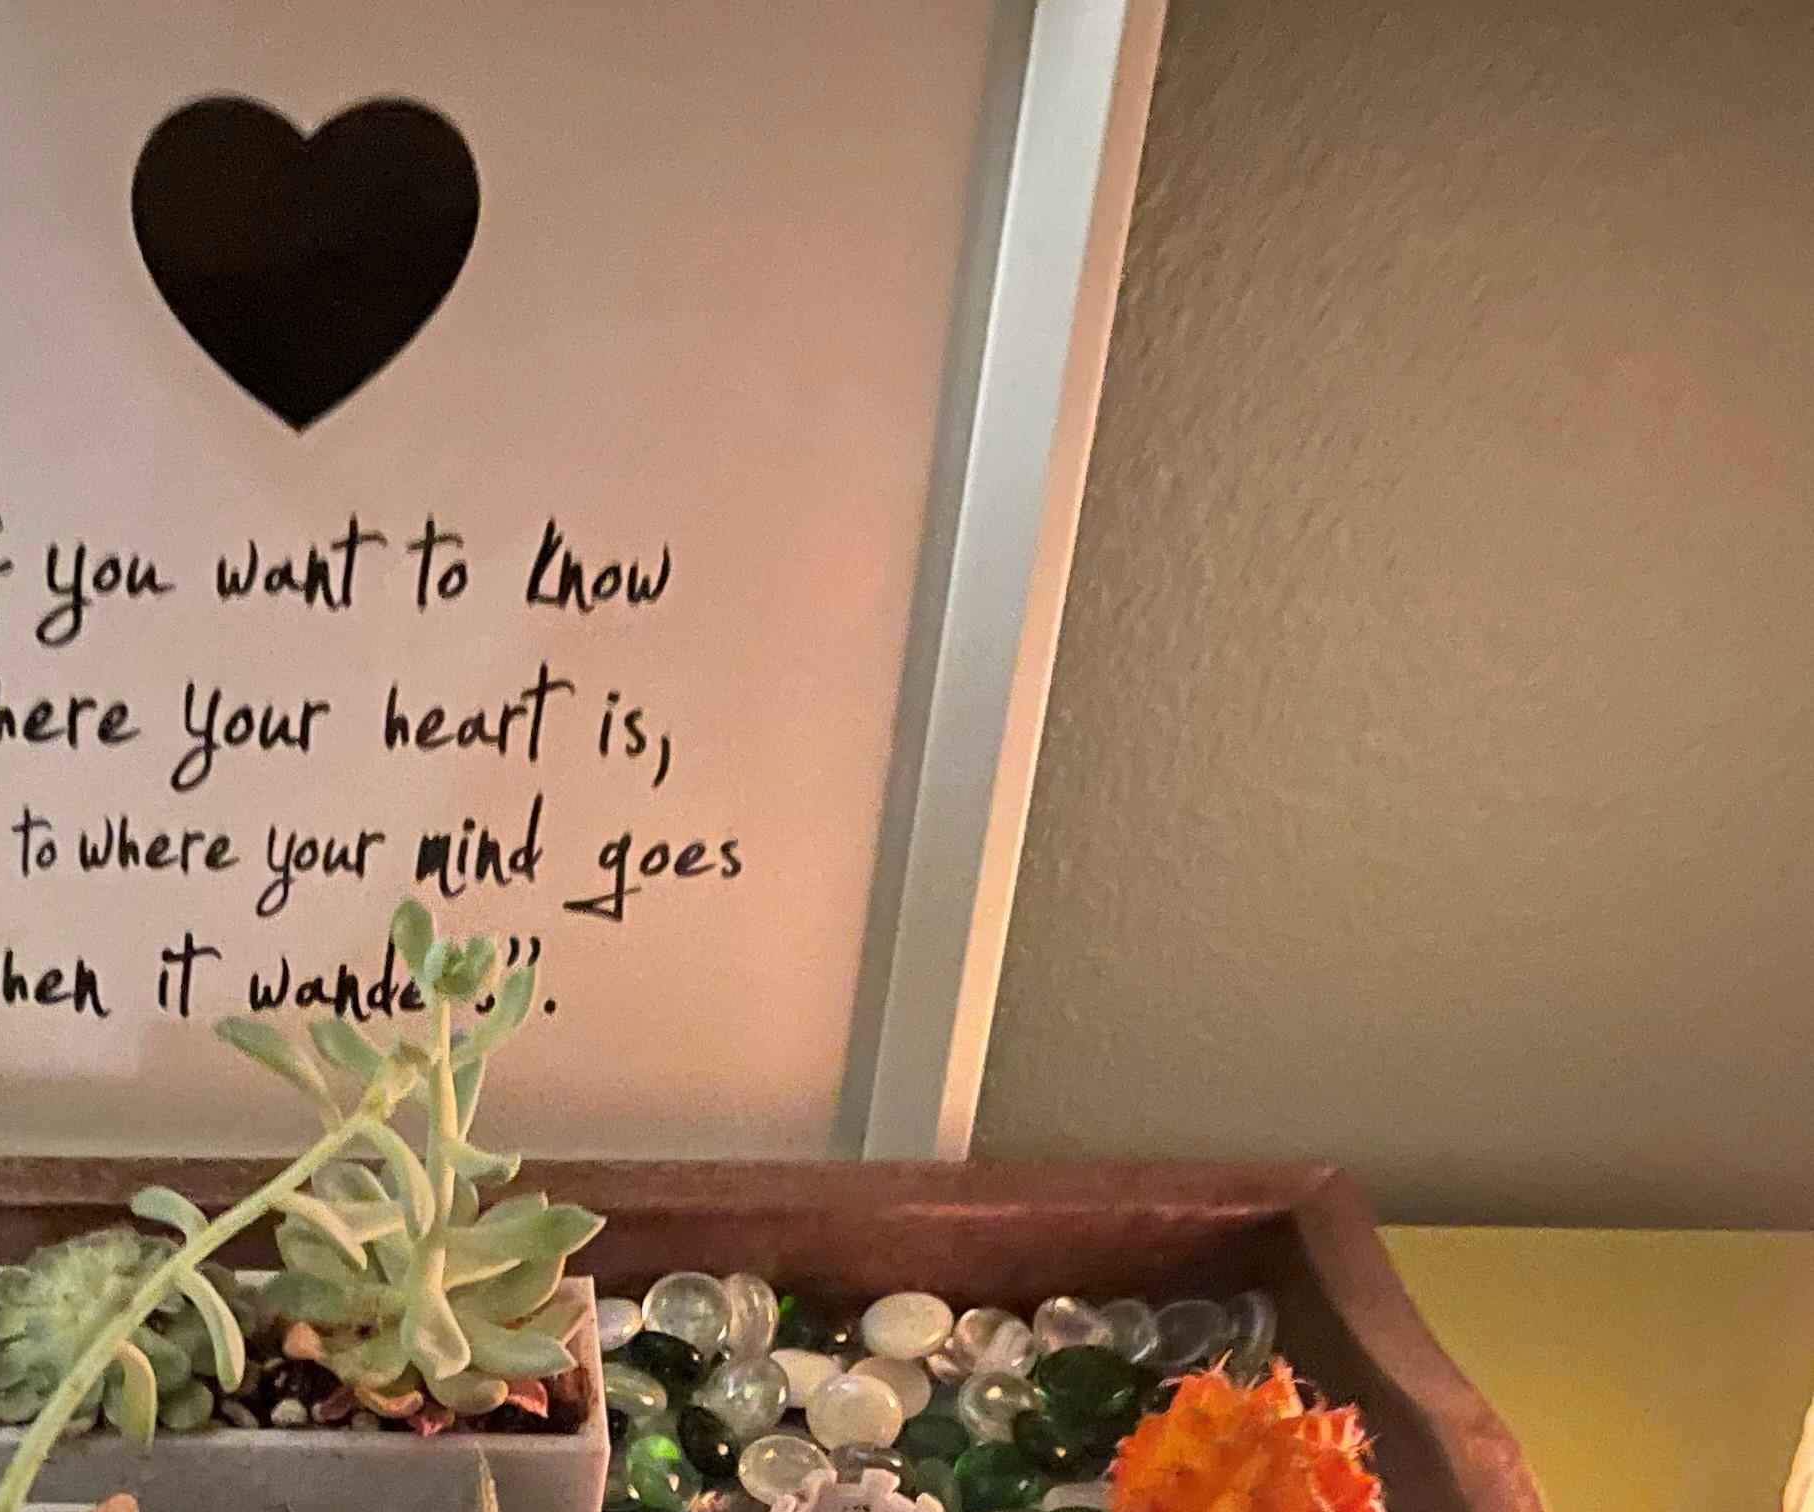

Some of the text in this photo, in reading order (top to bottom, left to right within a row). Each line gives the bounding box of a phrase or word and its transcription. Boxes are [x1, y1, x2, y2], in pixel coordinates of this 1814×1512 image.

[34, 540, 177, 649] you
[215, 512, 389, 614] want
[405, 514, 470, 616] to
[169, 679, 332, 794] your
[382, 660, 577, 765] heart
[597, 690, 672, 789] is,
[10, 804, 59, 878] to
[77, 814, 241, 876] where
[254, 823, 387, 919] your
[414, 791, 545, 899] mind
[562, 831, 743, 923] goes
[156, 930, 224, 1019] it
